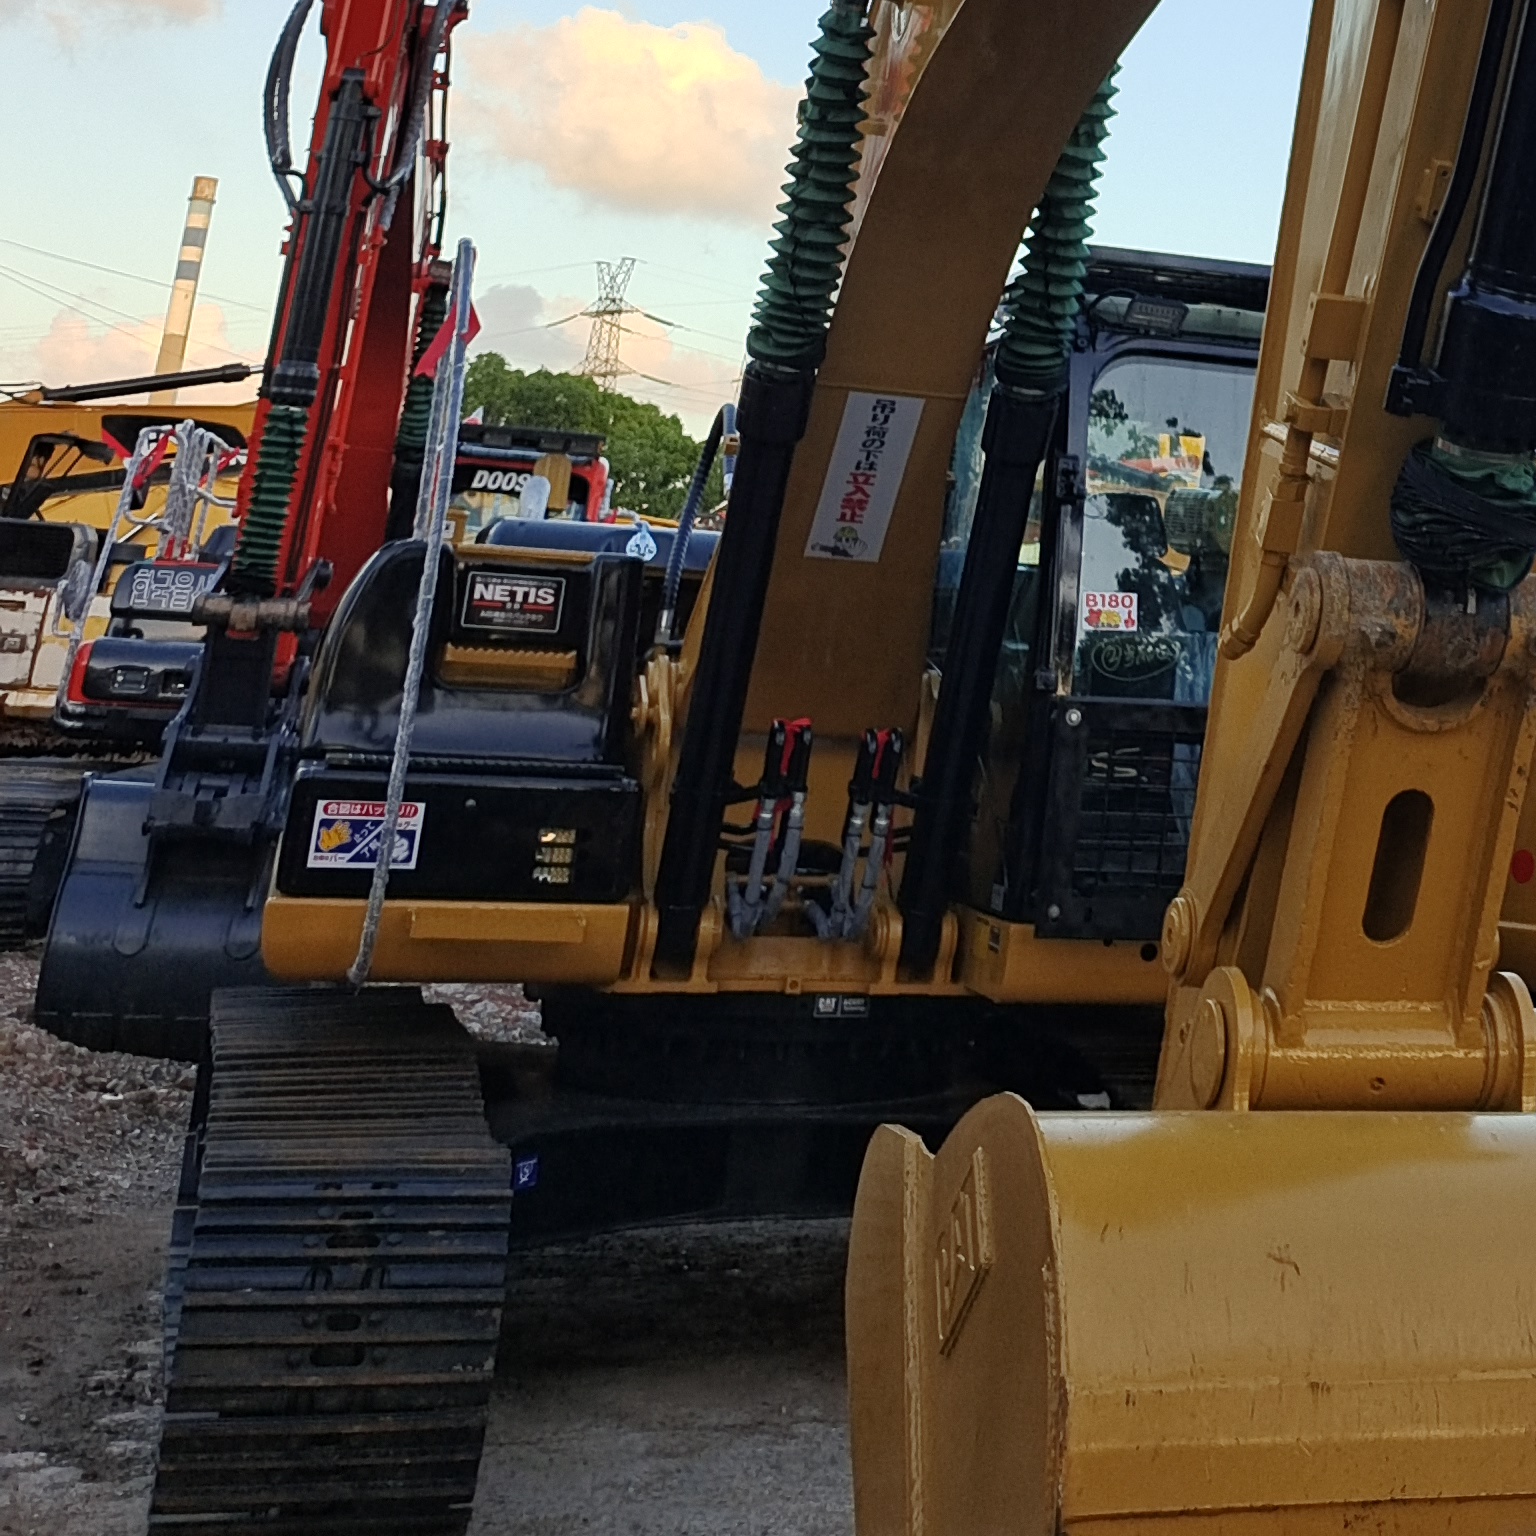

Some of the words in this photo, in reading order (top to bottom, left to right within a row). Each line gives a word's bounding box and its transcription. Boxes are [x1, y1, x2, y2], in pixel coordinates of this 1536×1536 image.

[474, 583, 555, 604] NETIS
[1086, 593, 1134, 609] B180
[327, 804, 415, 817] 合図はハッリ!!
